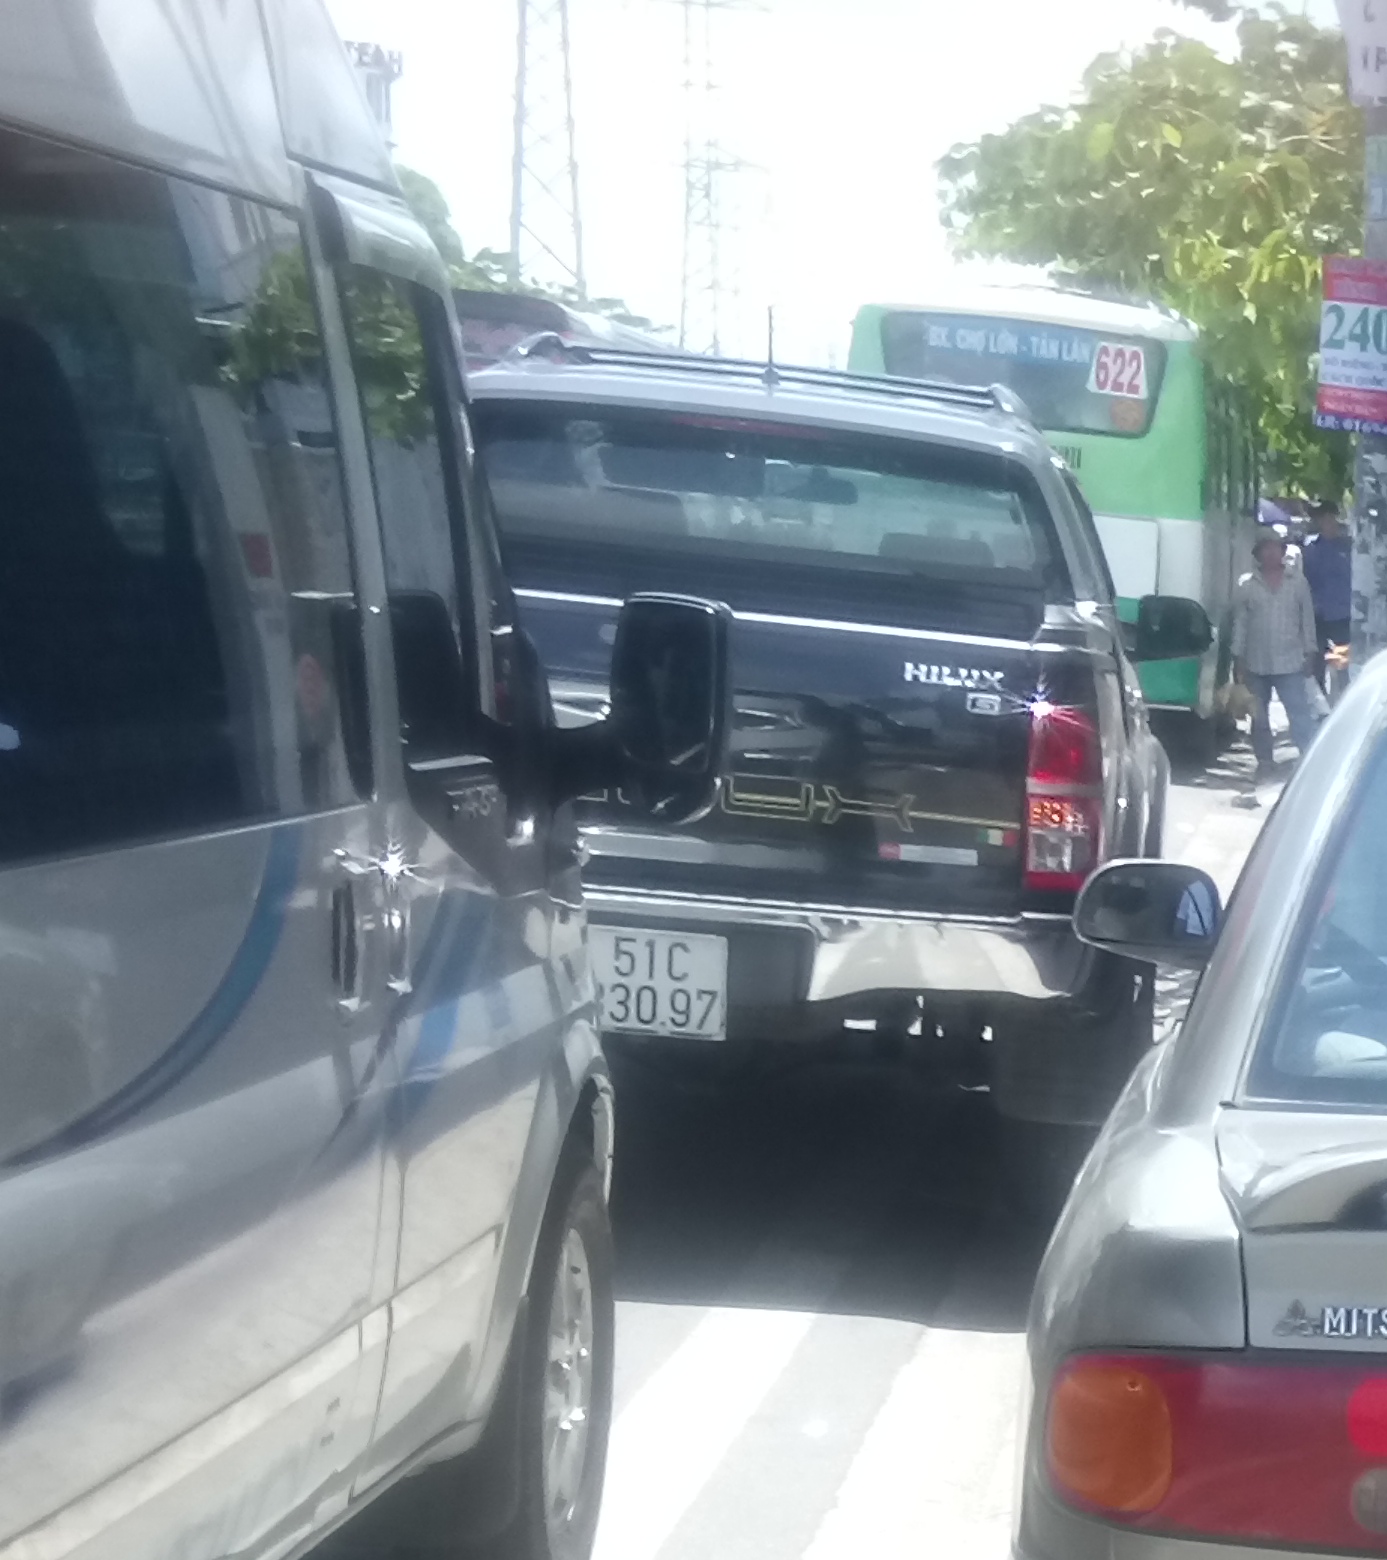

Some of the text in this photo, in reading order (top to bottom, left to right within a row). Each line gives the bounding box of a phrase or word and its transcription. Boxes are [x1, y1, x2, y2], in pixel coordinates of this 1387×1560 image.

[1095, 345, 1142, 395] 622
[904, 661, 1006, 691] HILUX
[613, 935, 691, 982] 51C
